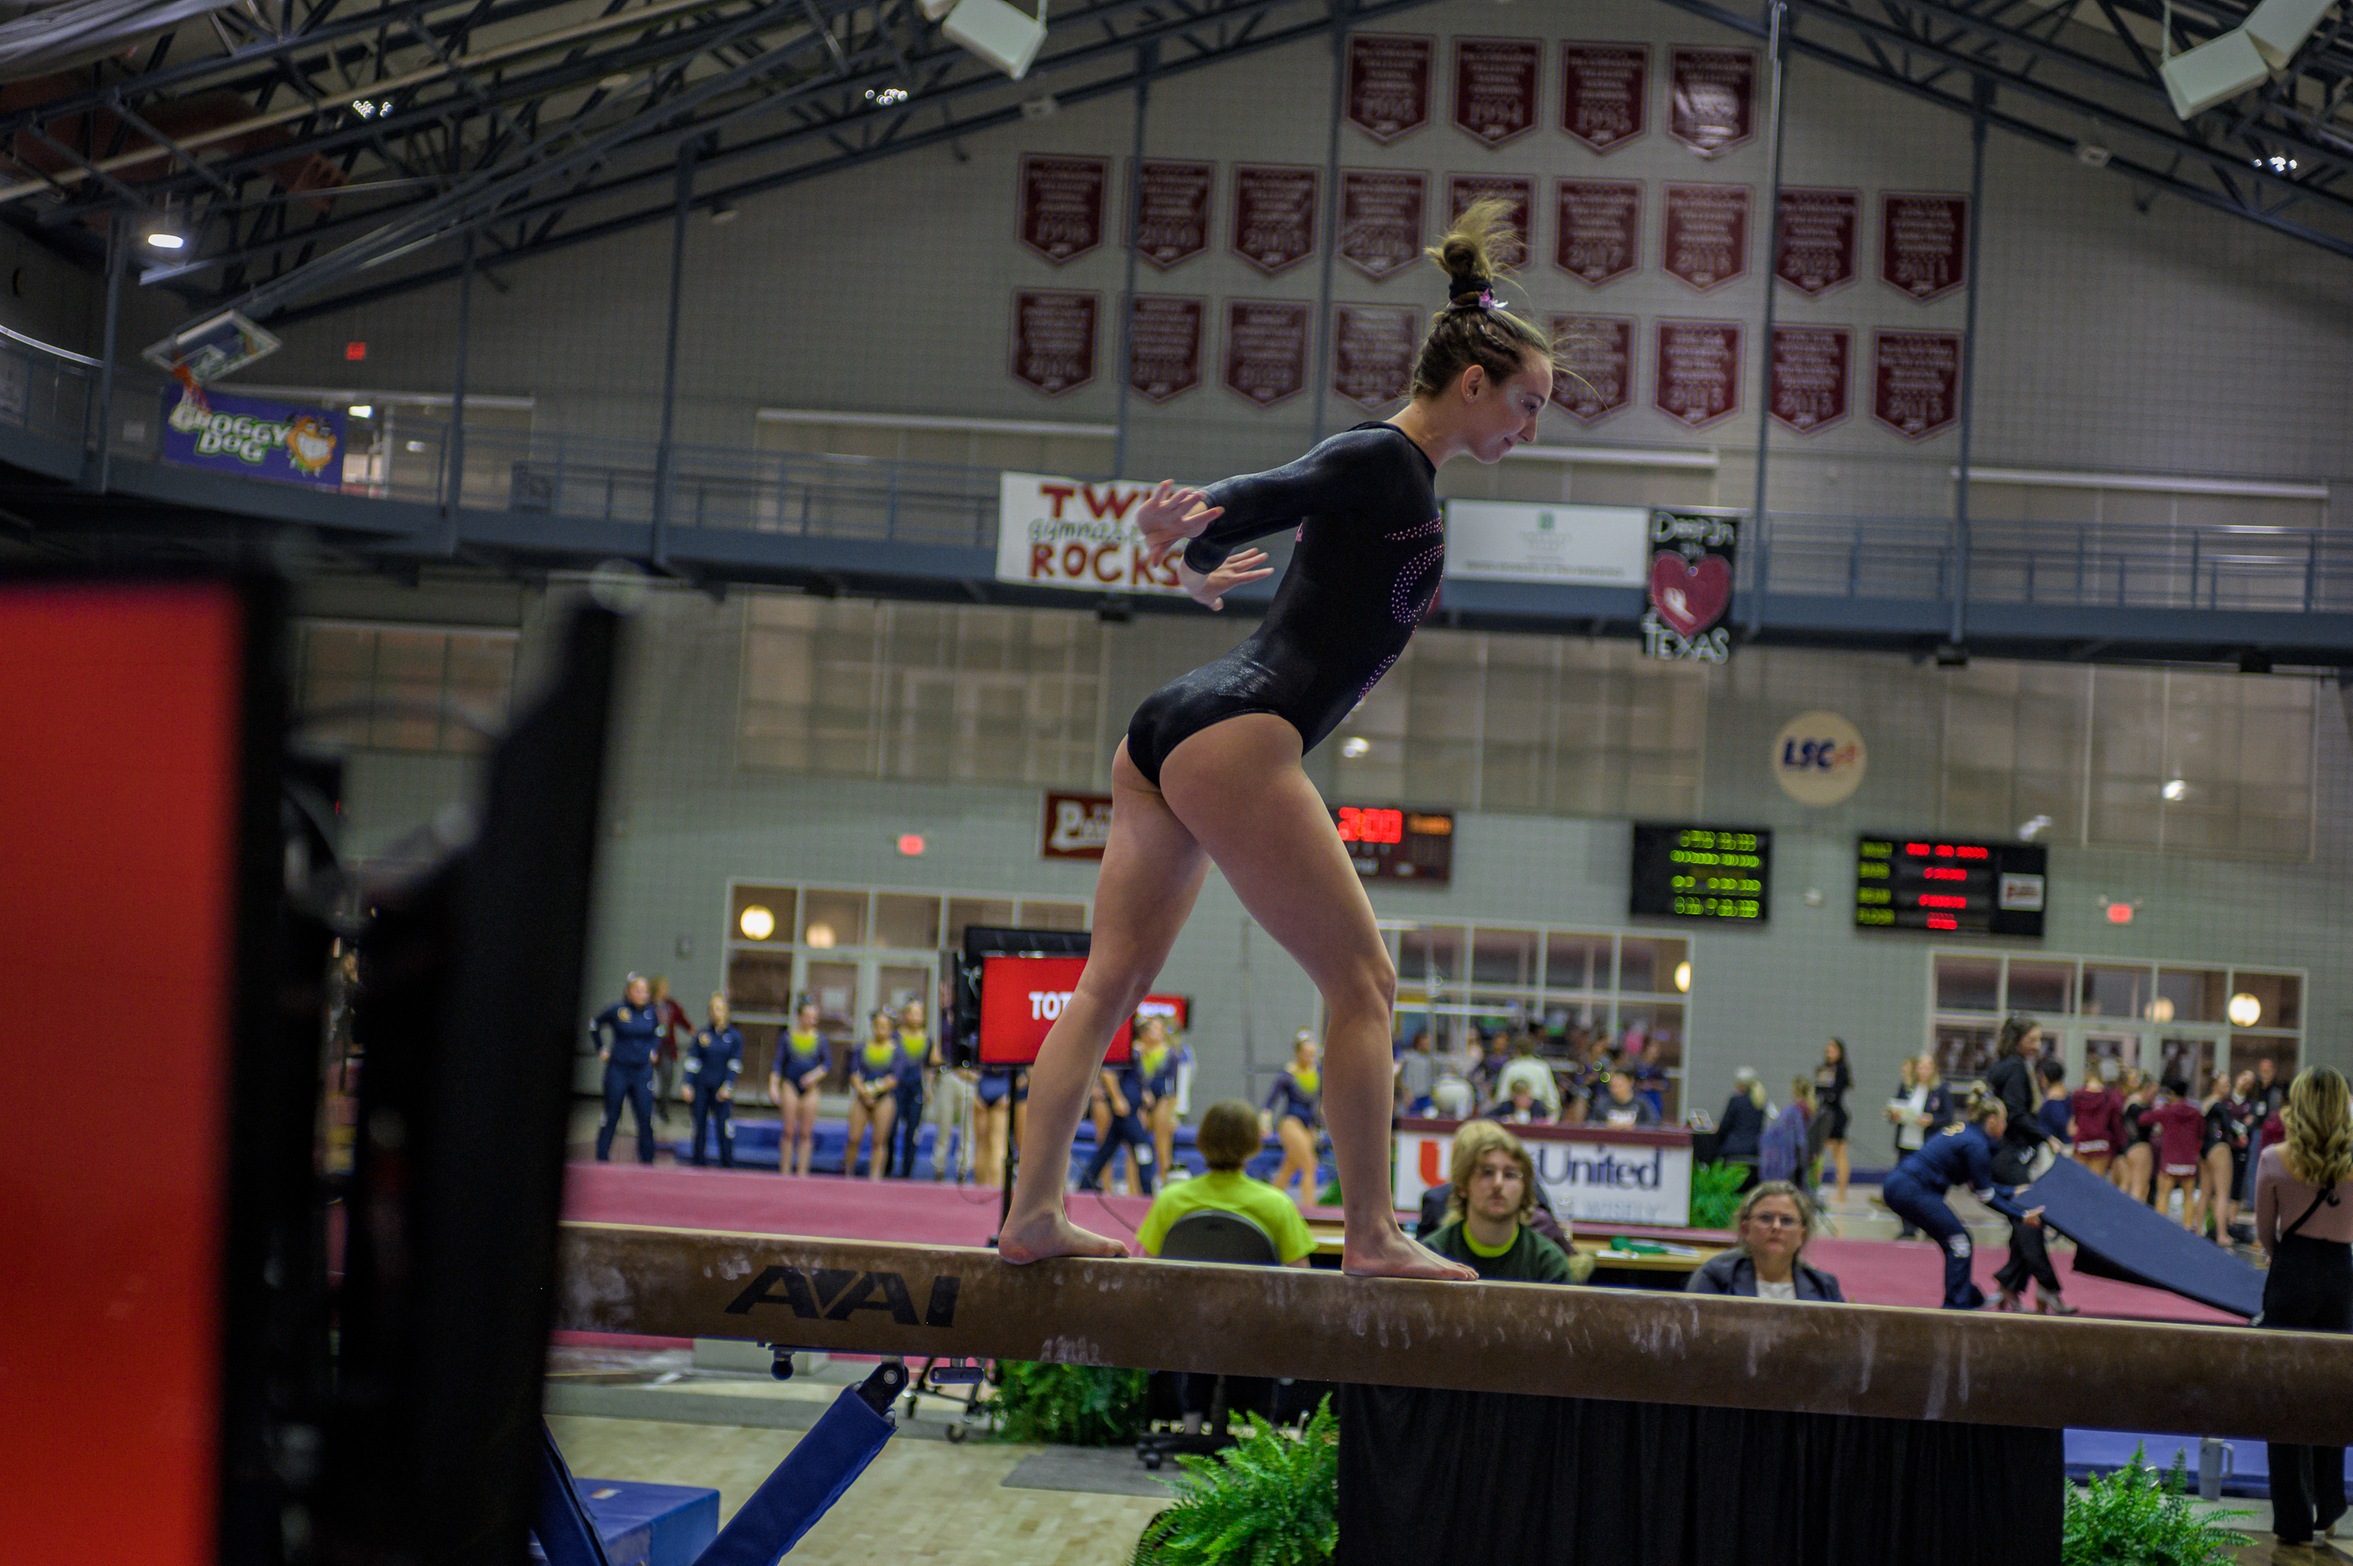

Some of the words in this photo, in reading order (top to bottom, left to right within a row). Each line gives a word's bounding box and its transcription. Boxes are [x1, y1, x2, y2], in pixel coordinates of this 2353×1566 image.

[1039, 483, 1155, 521] TW
[1030, 542, 1184, 587] ROCKS
[1642, 627, 1731, 665] TEXAS
[1783, 737, 1835, 771] LSC
[1538, 1142, 1664, 1190] United
